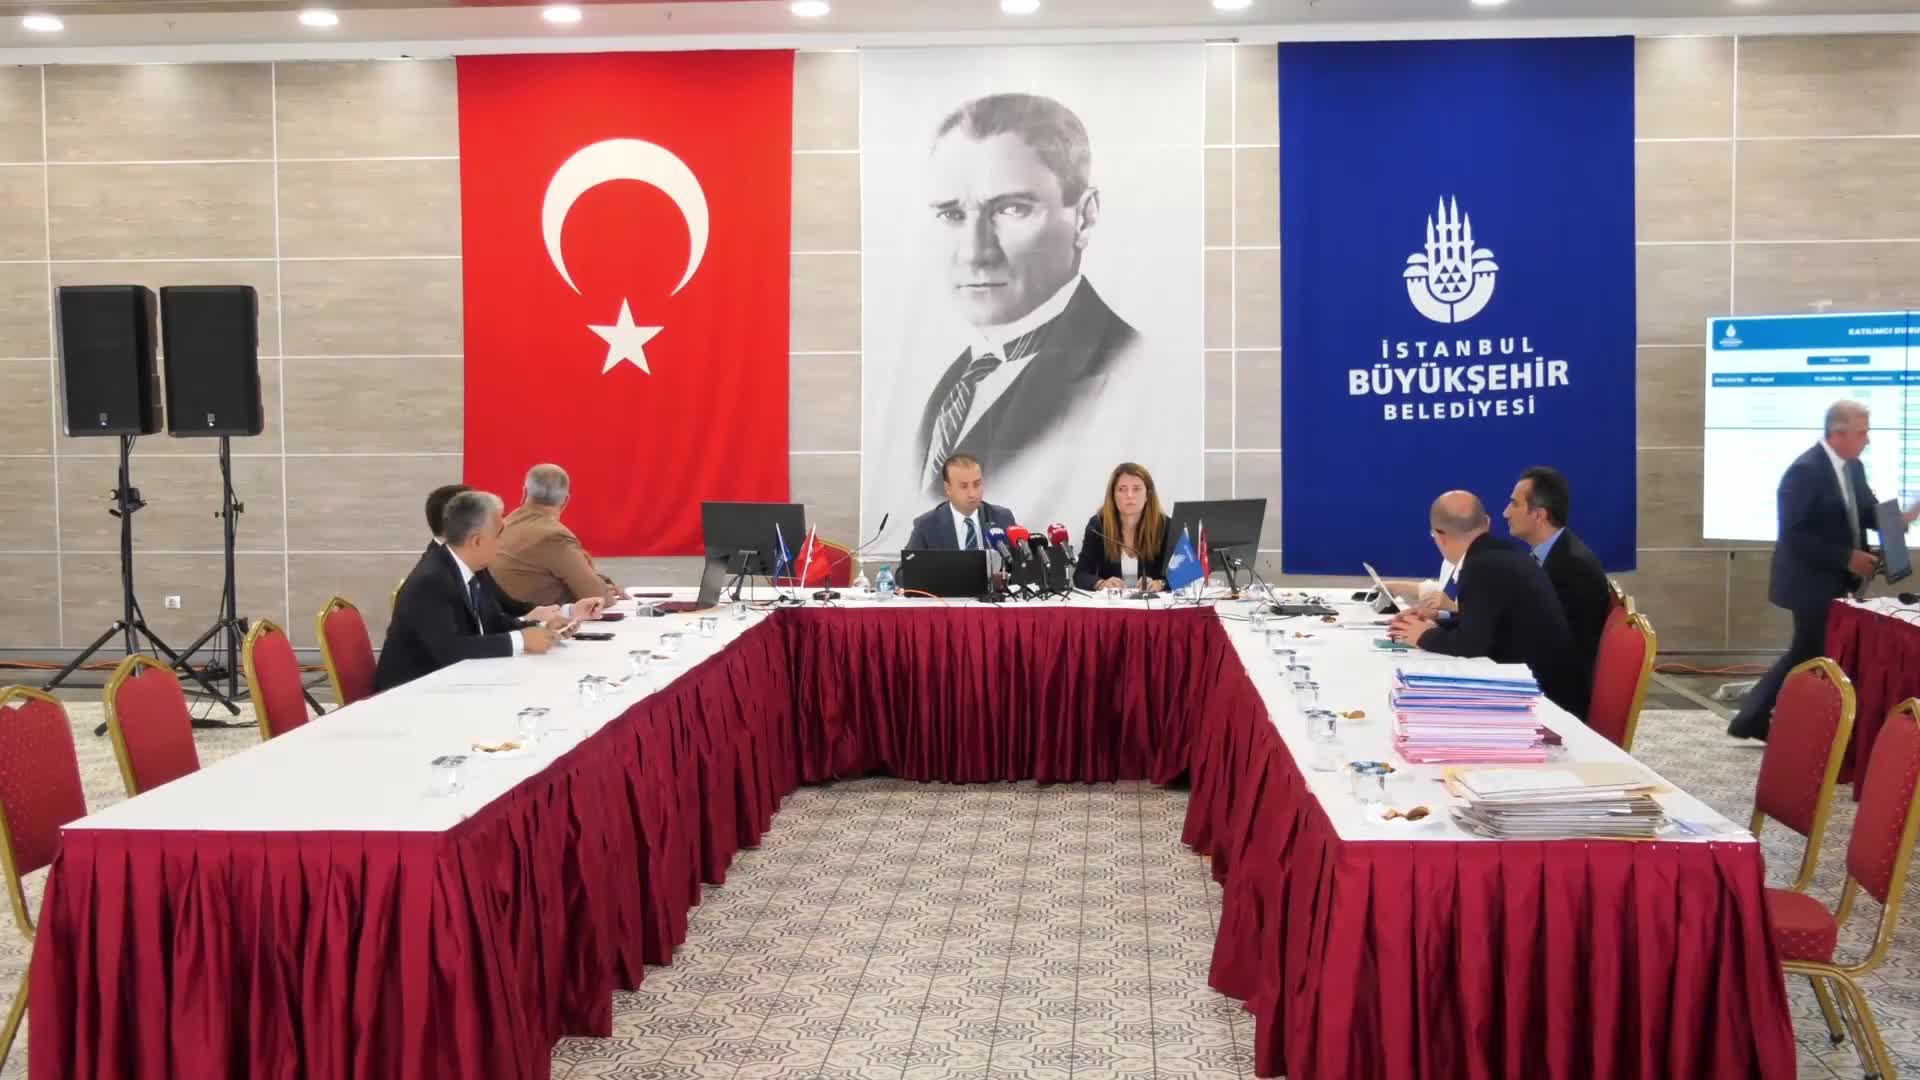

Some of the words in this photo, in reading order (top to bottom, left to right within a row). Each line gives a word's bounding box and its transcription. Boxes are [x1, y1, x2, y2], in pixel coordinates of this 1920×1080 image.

[1382, 336, 1534, 359] İSTANBUL
[1348, 356, 1569, 396] BÜYÜKŞEHİR
[1383, 394, 1536, 421] BELEDİYESİ
